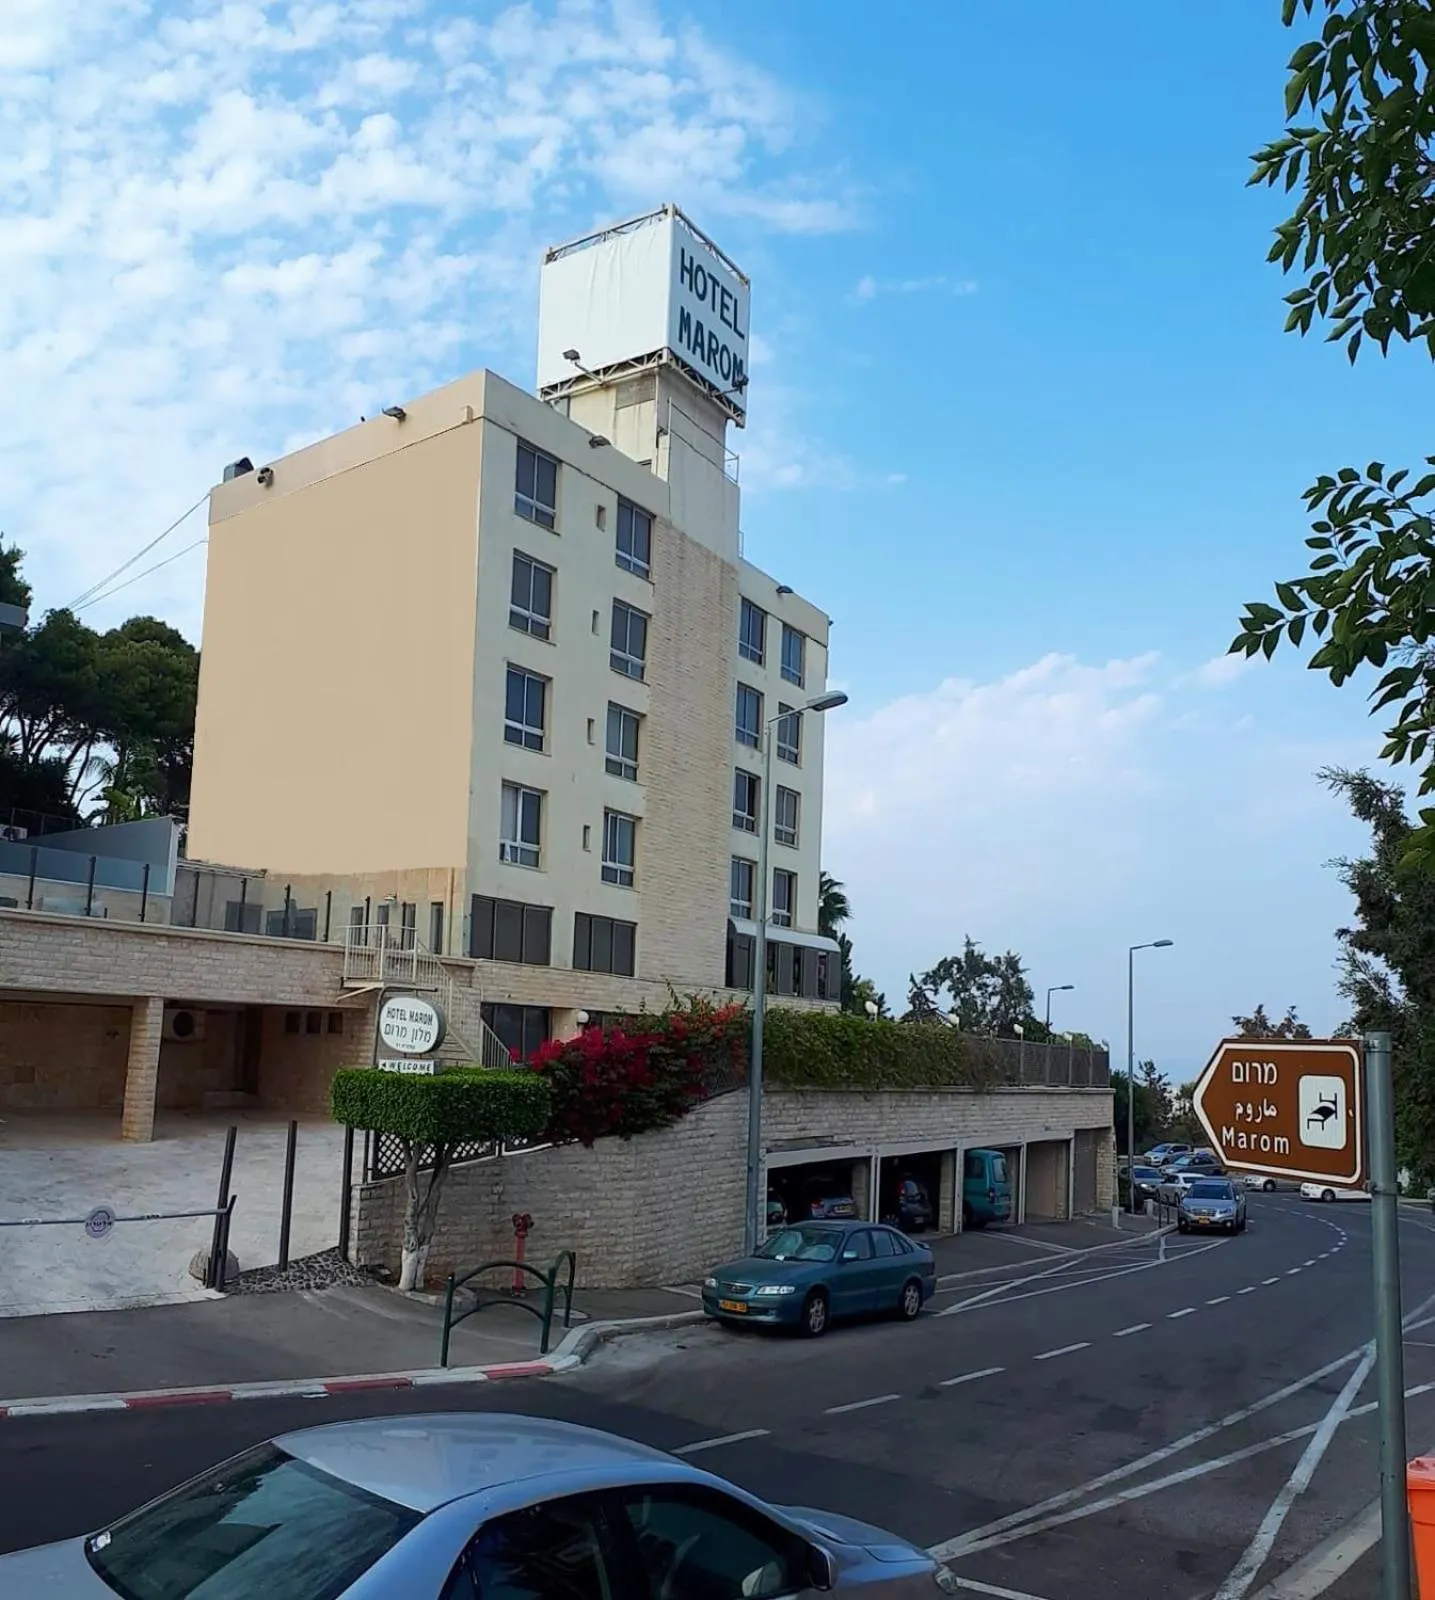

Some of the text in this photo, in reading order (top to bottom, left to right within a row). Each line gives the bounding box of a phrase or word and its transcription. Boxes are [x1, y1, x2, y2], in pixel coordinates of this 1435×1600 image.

[680, 247, 745, 340] HOTEL
[678, 305, 745, 395] MAROM
[386, 1007, 433, 1026] HOTEL MAROM
[384, 1023, 432, 1043] מלון מרום
[389, 1061, 431, 1071] WELCOME
[1232, 1061, 1278, 1084] מרום
[1235, 1098, 1278, 1123] ماروم
[1222, 1125, 1290, 1154] Marom
